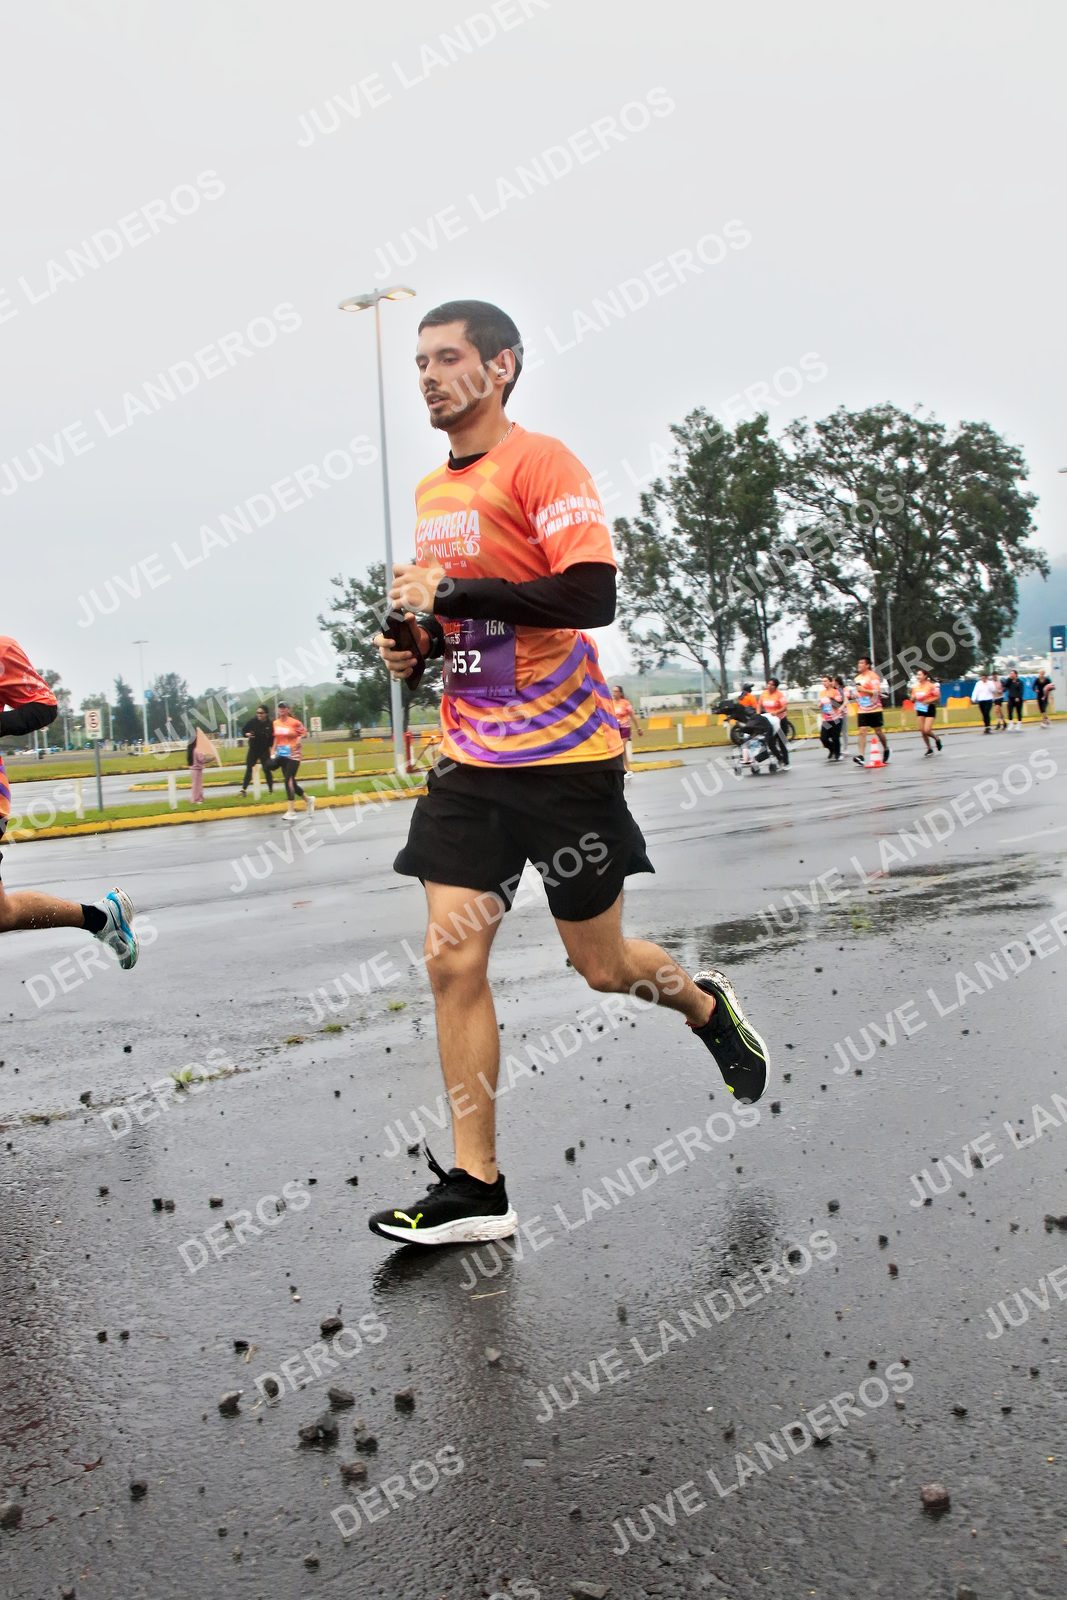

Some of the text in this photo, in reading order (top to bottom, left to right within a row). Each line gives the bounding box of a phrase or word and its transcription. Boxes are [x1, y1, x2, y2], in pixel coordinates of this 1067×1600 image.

[416, 509, 480, 543] CARRERA
[416, 541, 463, 562] ONILIFE
[485, 620, 505, 636] 15K
[1053, 637, 1063, 649] E
